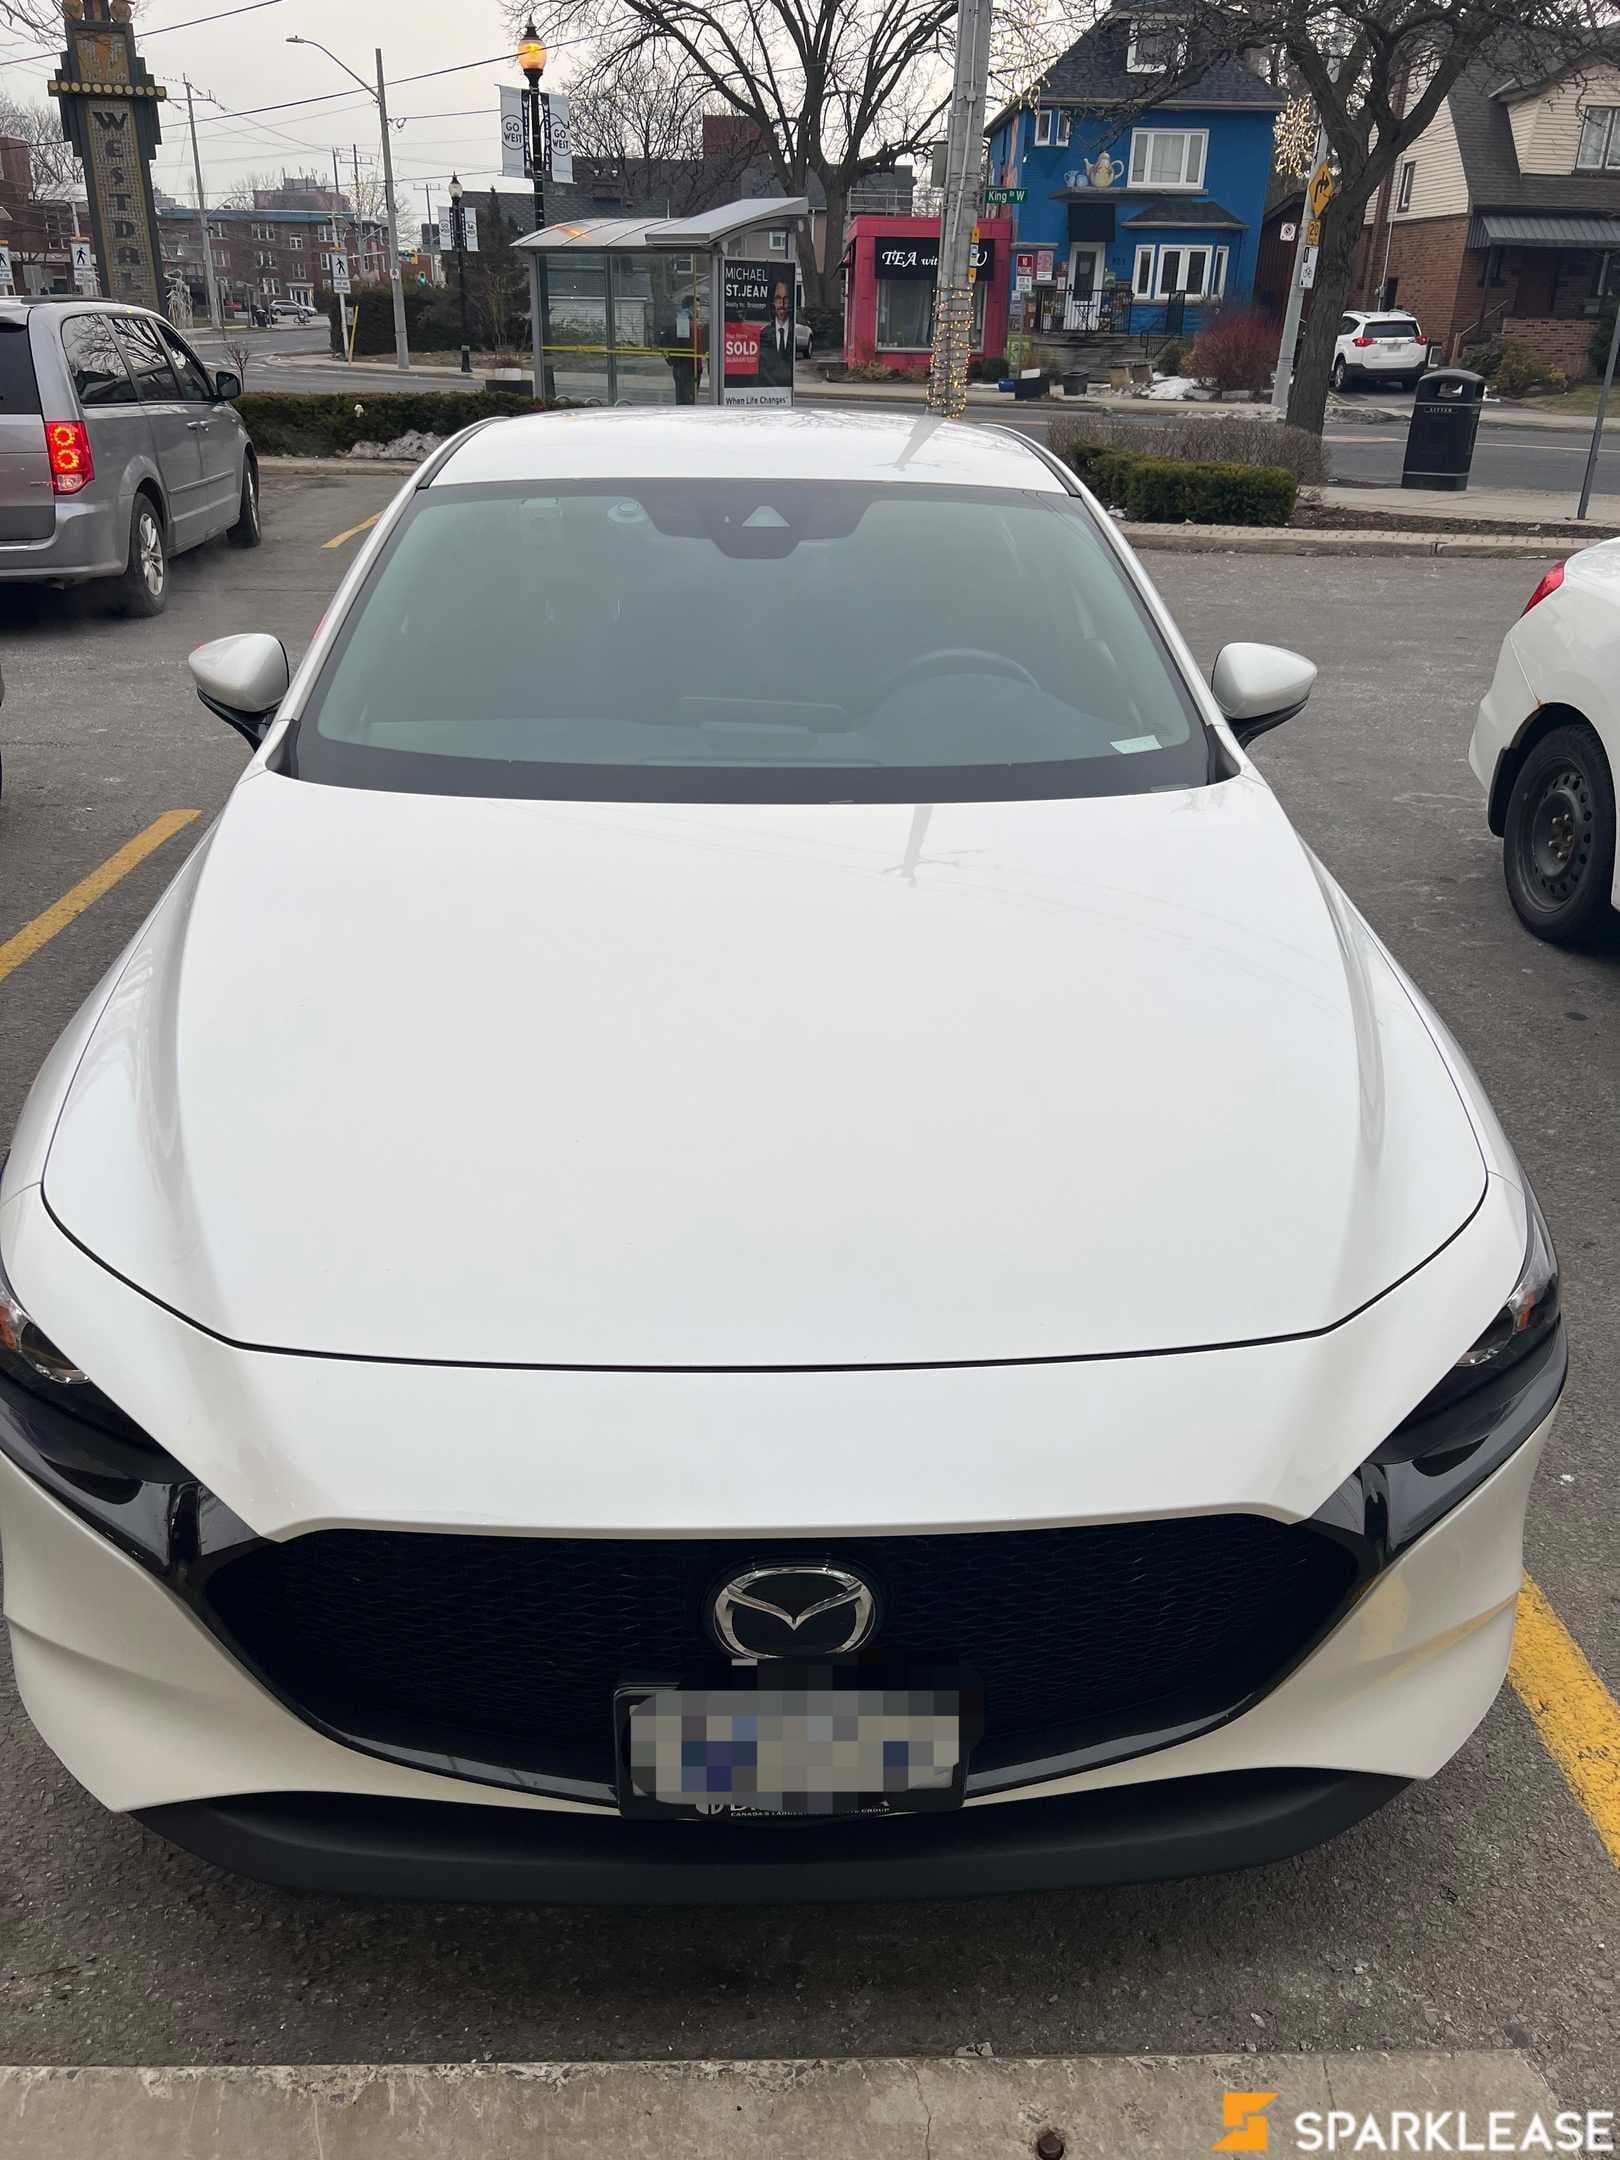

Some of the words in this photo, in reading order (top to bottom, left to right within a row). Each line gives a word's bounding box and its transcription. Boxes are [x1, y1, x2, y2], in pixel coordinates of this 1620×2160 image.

[506, 122, 520, 132] GO
[504, 132, 522, 143] WEST
[554, 129, 566, 138] GO
[552, 140, 569, 149] WEST
[93, 111, 141, 289] WESTDAL
[988, 191, 1007, 203] King
[1016, 191, 1025, 200] W
[882, 250, 918, 268] TEA
[921, 256, 939, 266] wit
[725, 267, 768, 282] MICHAEL
[725, 284, 768, 298] ST.JEAN
[726, 341, 758, 355] SOLD
[726, 396, 745, 405] When
